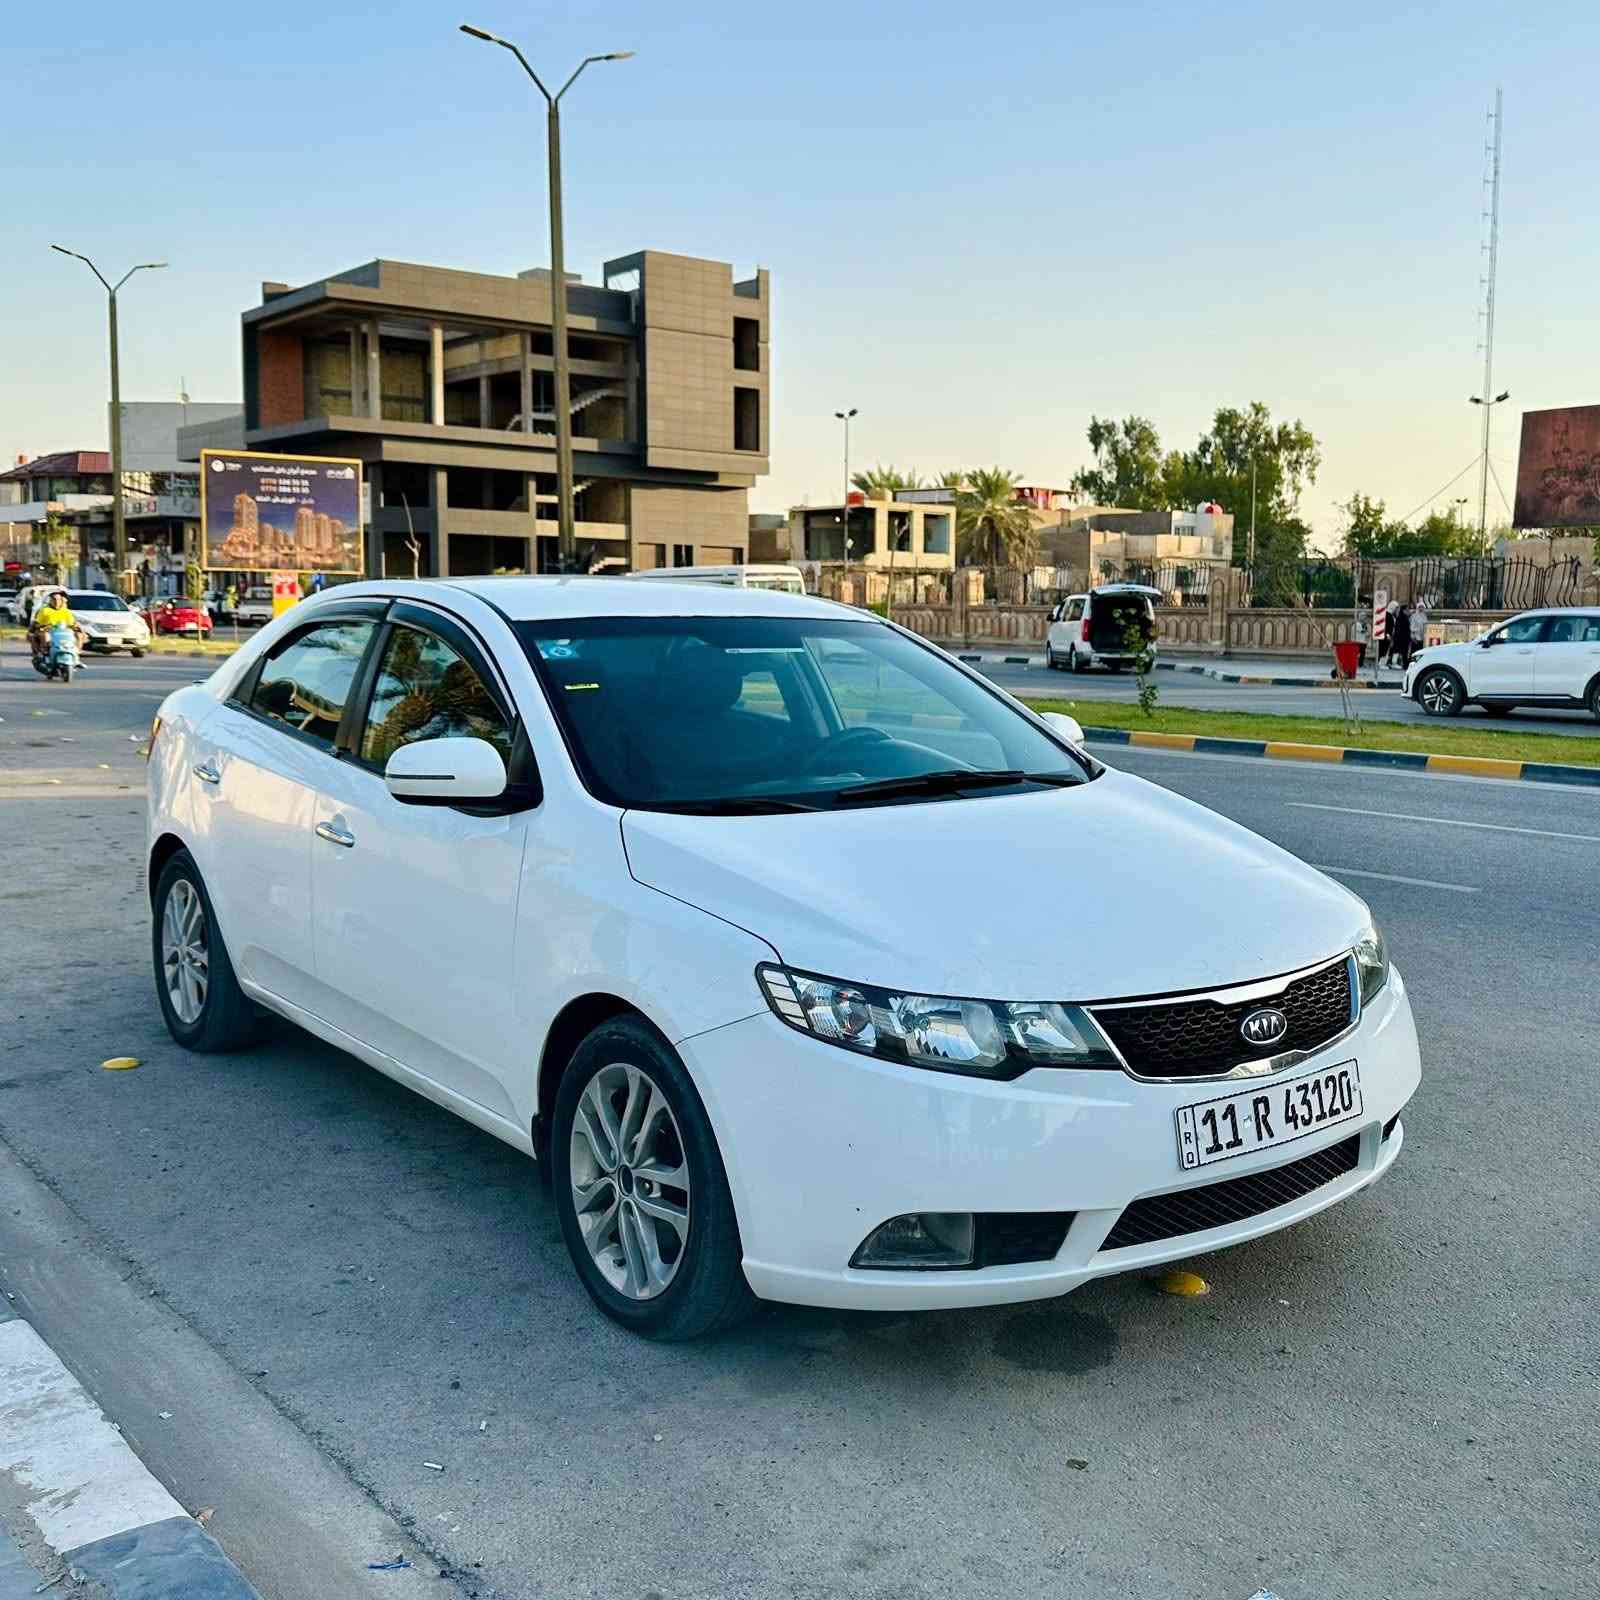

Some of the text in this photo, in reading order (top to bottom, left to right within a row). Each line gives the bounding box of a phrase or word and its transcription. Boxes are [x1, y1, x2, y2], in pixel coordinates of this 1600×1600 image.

[1248, 1015, 1281, 1039] KIA
[1202, 1070, 1352, 1155] 11 R 43120
